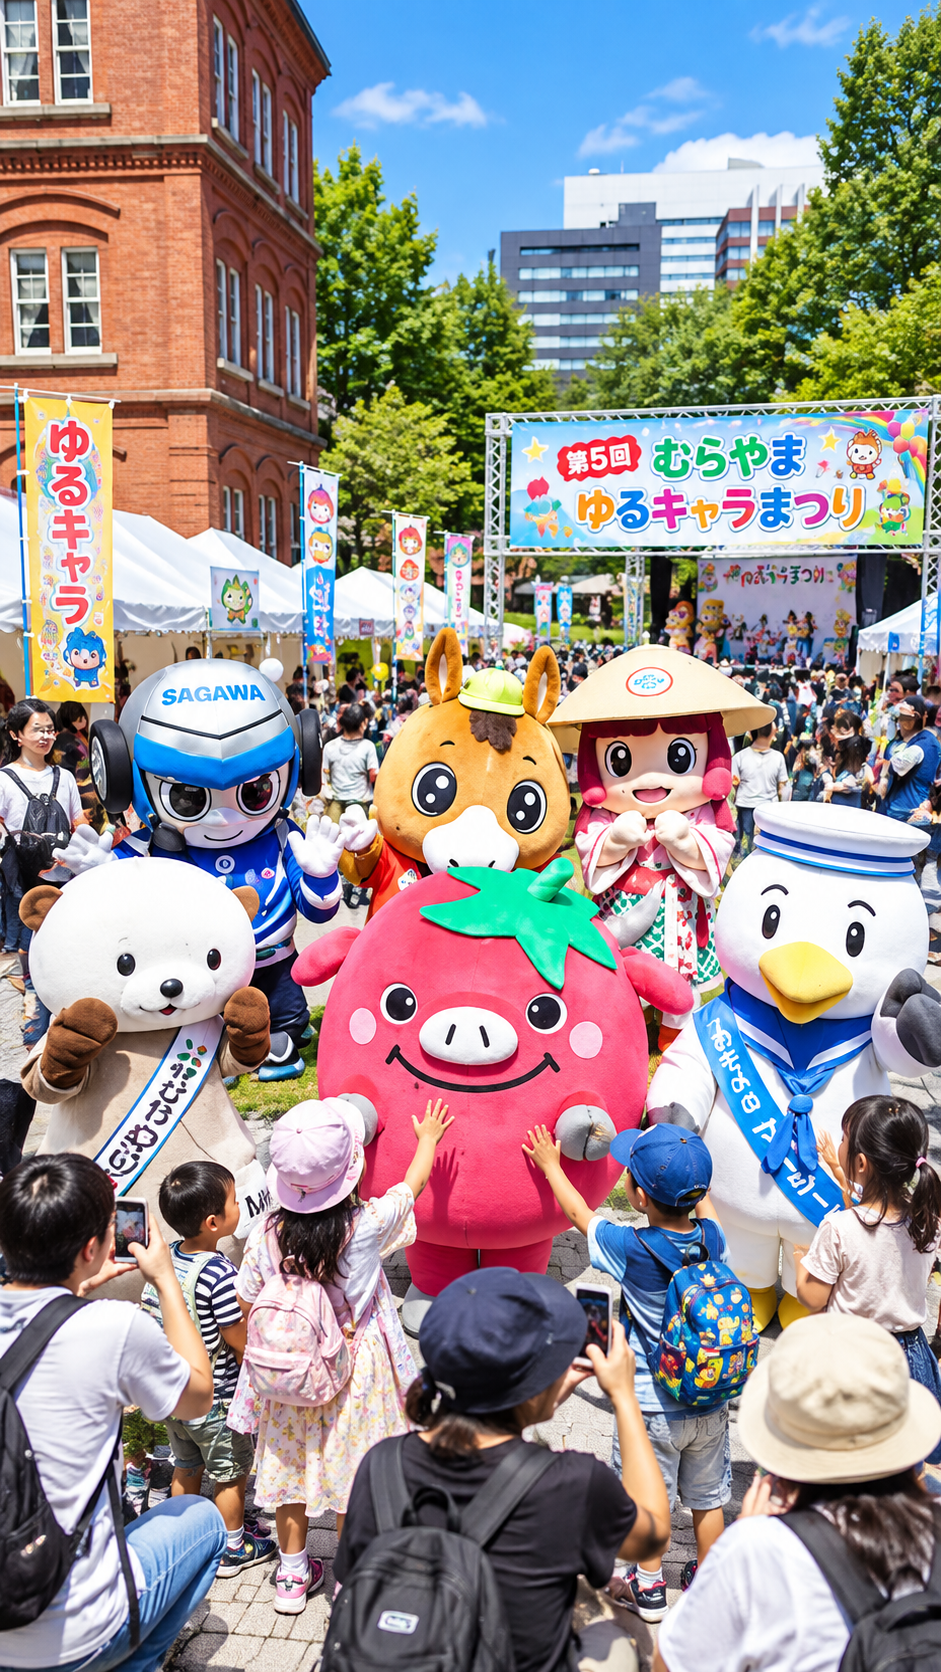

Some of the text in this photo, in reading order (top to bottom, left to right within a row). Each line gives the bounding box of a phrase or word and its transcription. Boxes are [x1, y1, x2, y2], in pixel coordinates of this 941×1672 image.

[566, 443, 632, 475] 第5回
[653, 434, 803, 478] むらやま
[49, 420, 90, 625] ゆるキャラ
[577, 487, 863, 530] ゆるキャラまつり
[161, 684, 266, 706] SAGAWA
